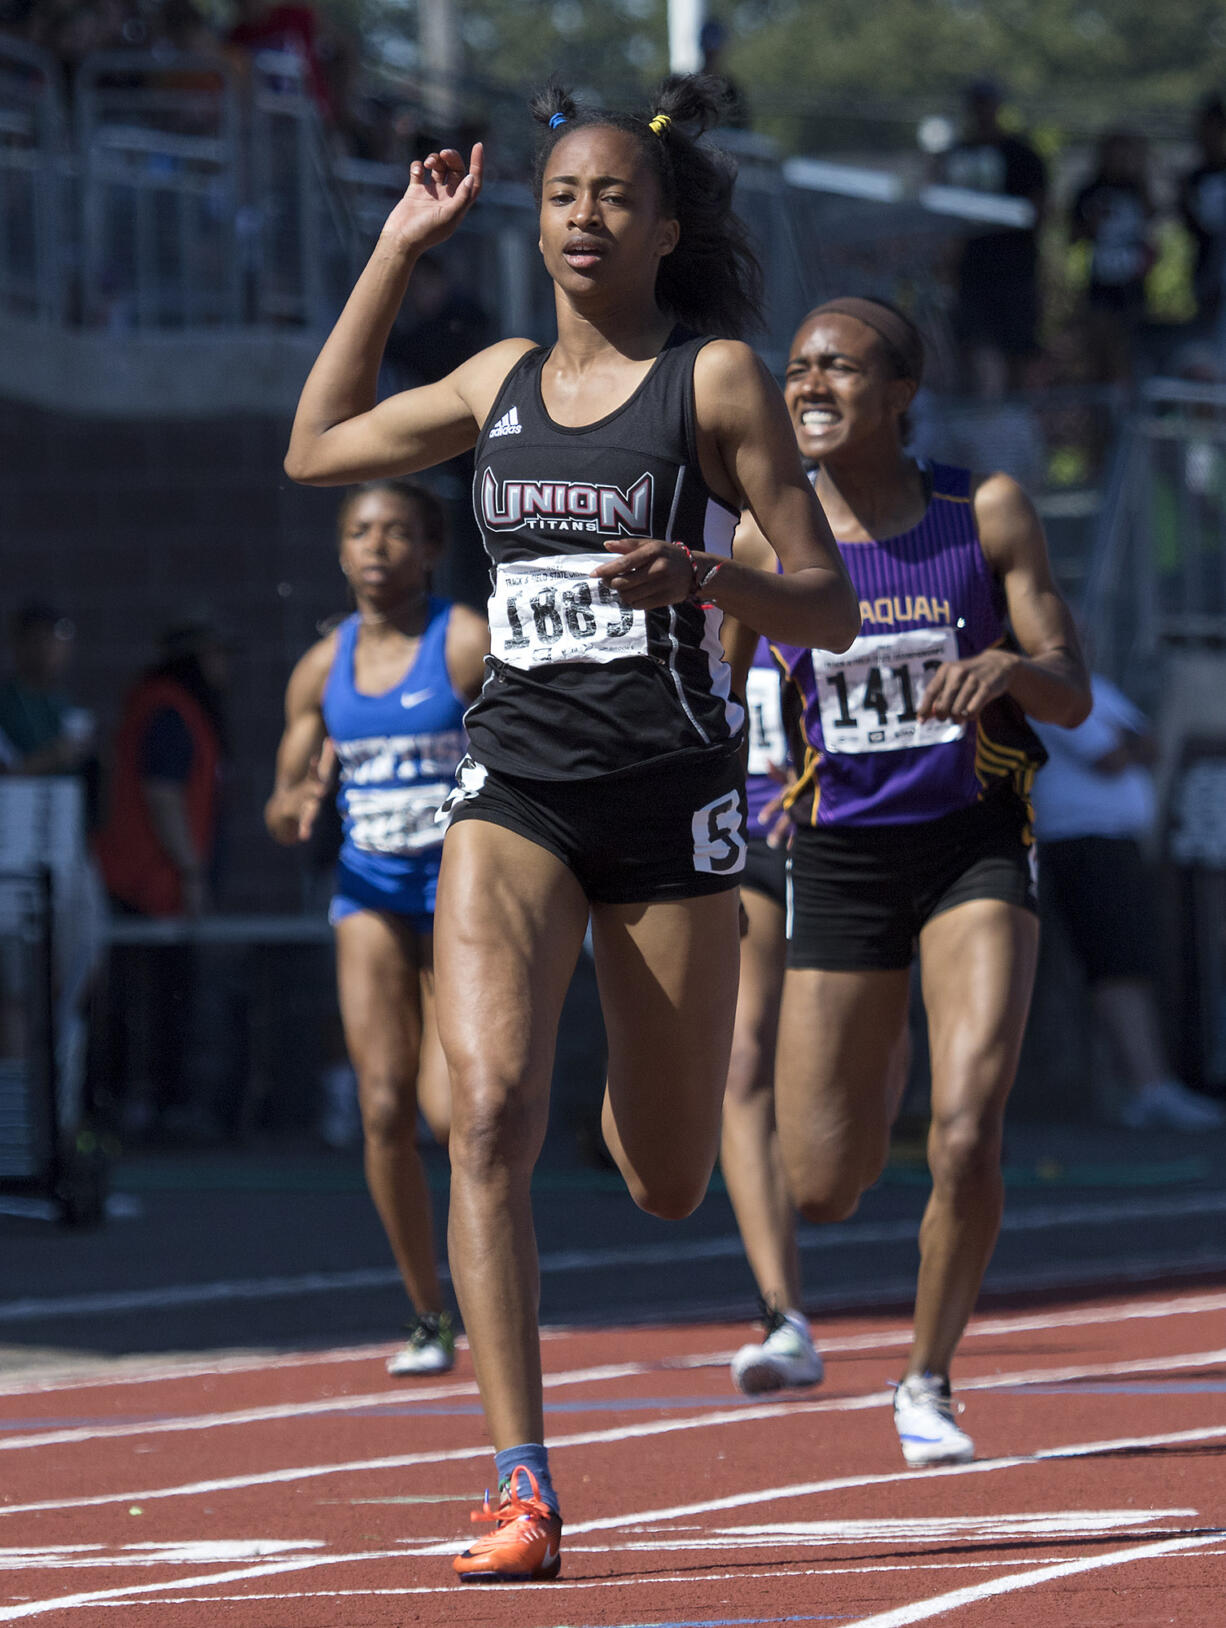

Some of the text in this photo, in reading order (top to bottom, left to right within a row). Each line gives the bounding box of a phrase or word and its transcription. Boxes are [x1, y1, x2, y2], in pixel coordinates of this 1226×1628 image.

[489, 424, 523, 438] adidas
[482, 467, 654, 537] UNION
[526, 520, 597, 532] TITANS
[826, 659, 943, 728] 141
[707, 797, 740, 872] 5
